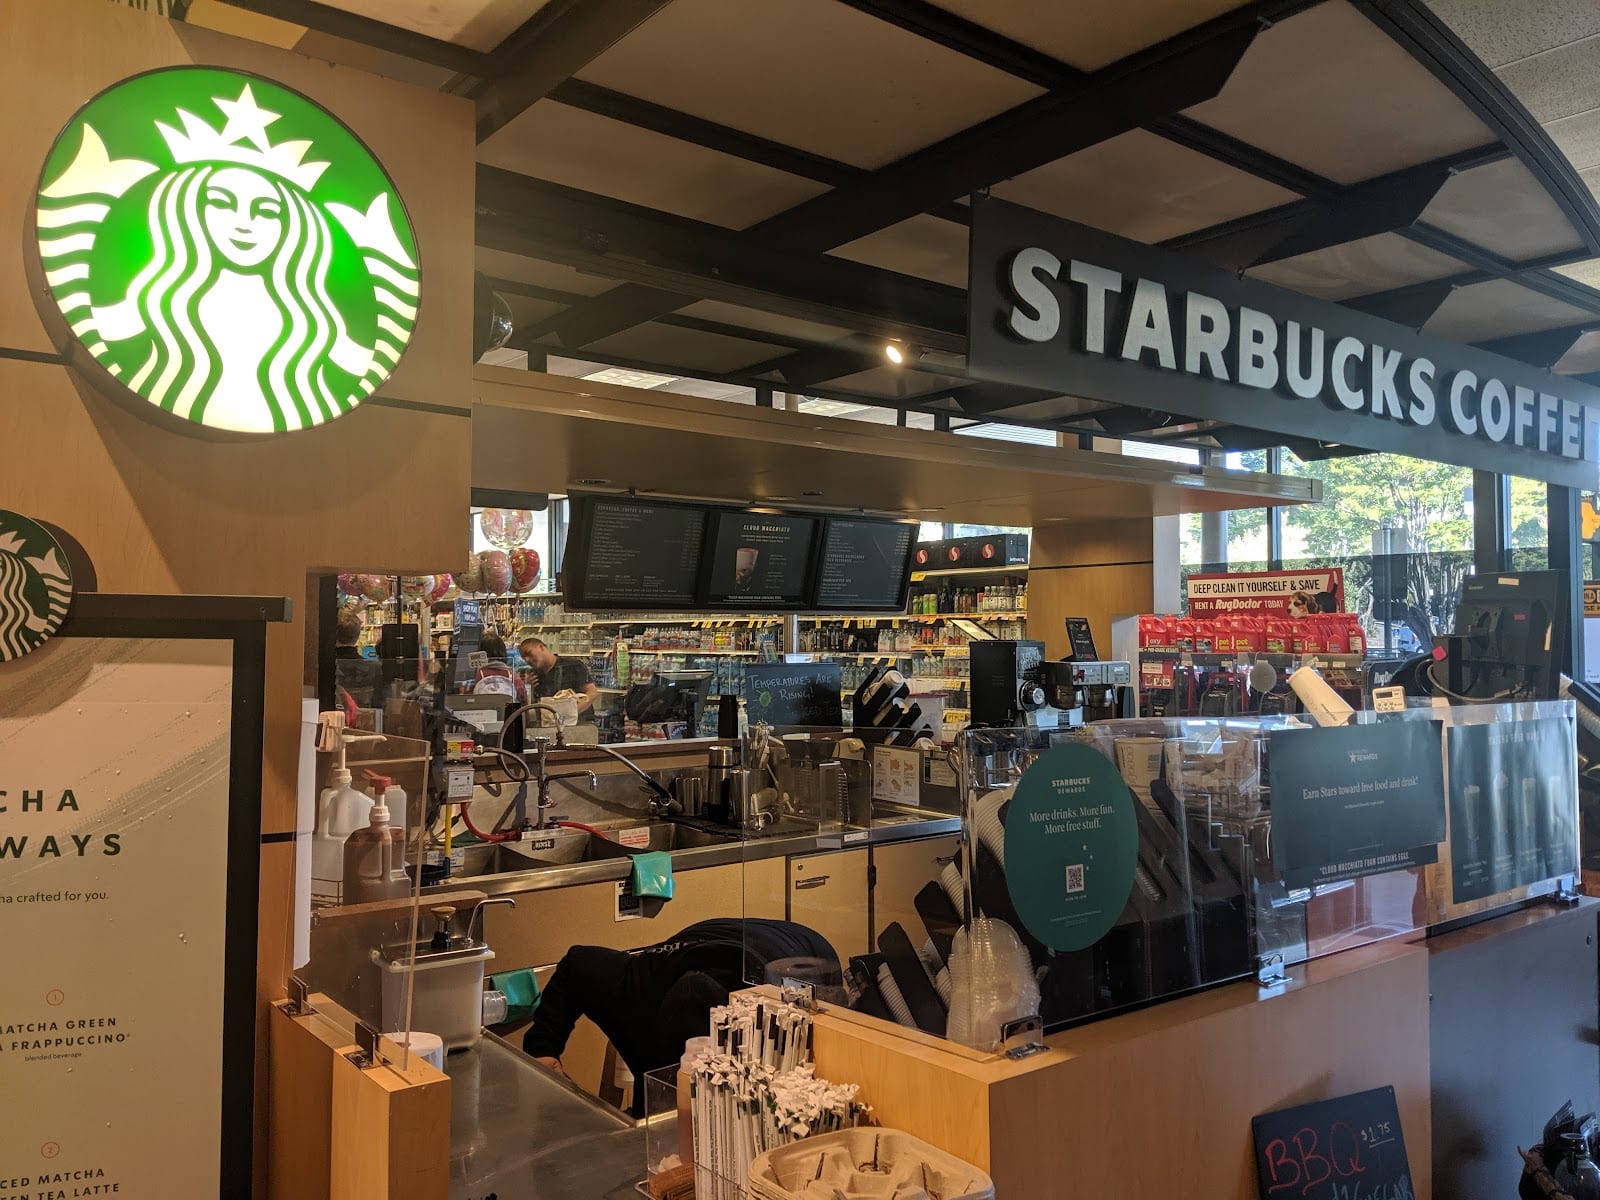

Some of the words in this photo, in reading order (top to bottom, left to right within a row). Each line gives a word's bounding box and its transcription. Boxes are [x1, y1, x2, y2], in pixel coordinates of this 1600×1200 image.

[1009, 247, 1435, 427] STARBUCKS
[1193, 583, 1212, 594] DEEP
[1213, 583, 1236, 594] CLEAN
[1237, 582, 1245, 593] IT
[1246, 580, 1288, 593] YOURSELF
[1290, 580, 1297, 591] &
[1298, 579, 1320, 591] SAVE
[1194, 600, 1209, 610] RENT
[1209, 601, 1214, 609] A
[1264, 600, 1285, 609] TODAY
[747, 674, 811, 690] TEMPERATURES
[1052, 777, 1091, 788] STARBUCKS
[1057, 786, 1086, 795] REWARDS
[1302, 788, 1320, 800] Earn
[1320, 786, 1338, 798] Stars
[1338, 783, 1360, 796] toward
[1361, 781, 1374, 793] free
[1374, 779, 1389, 791] food
[1389, 777, 1400, 789] and
[1029, 812, 1050, 823] More
[1051, 808, 1079, 821] drinks.
[1080, 806, 1099, 817] More
[1099, 804, 1115, 816] fun.
[1045, 823, 1066, 834] More
[1066, 821, 1081, 832] free
[1082, 817, 1102, 830] stuff.
[534, 839, 552, 849] RINSE
[1338, 859, 1363, 872] MACCHIATO
[1364, 857, 1376, 867] FOAM
[1376, 854, 1398, 865] CONTAINS
[16, 891, 61, 903] crafted
[64, 890, 82, 902] for
[85, 892, 109, 904] you.
[0, 1022, 58, 1035] ATCHA
[65, 1017, 117, 1030] GREEN
[24, 1053, 52, 1062] blended
[52, 1051, 82, 1060] beverage
[1264, 1120, 1367, 1197] BBQ
[38, 1168, 105, 1185] MATCHA
[37, 1190, 66, 1200] TEA
[73, 1183, 120, 1197] LATTE
